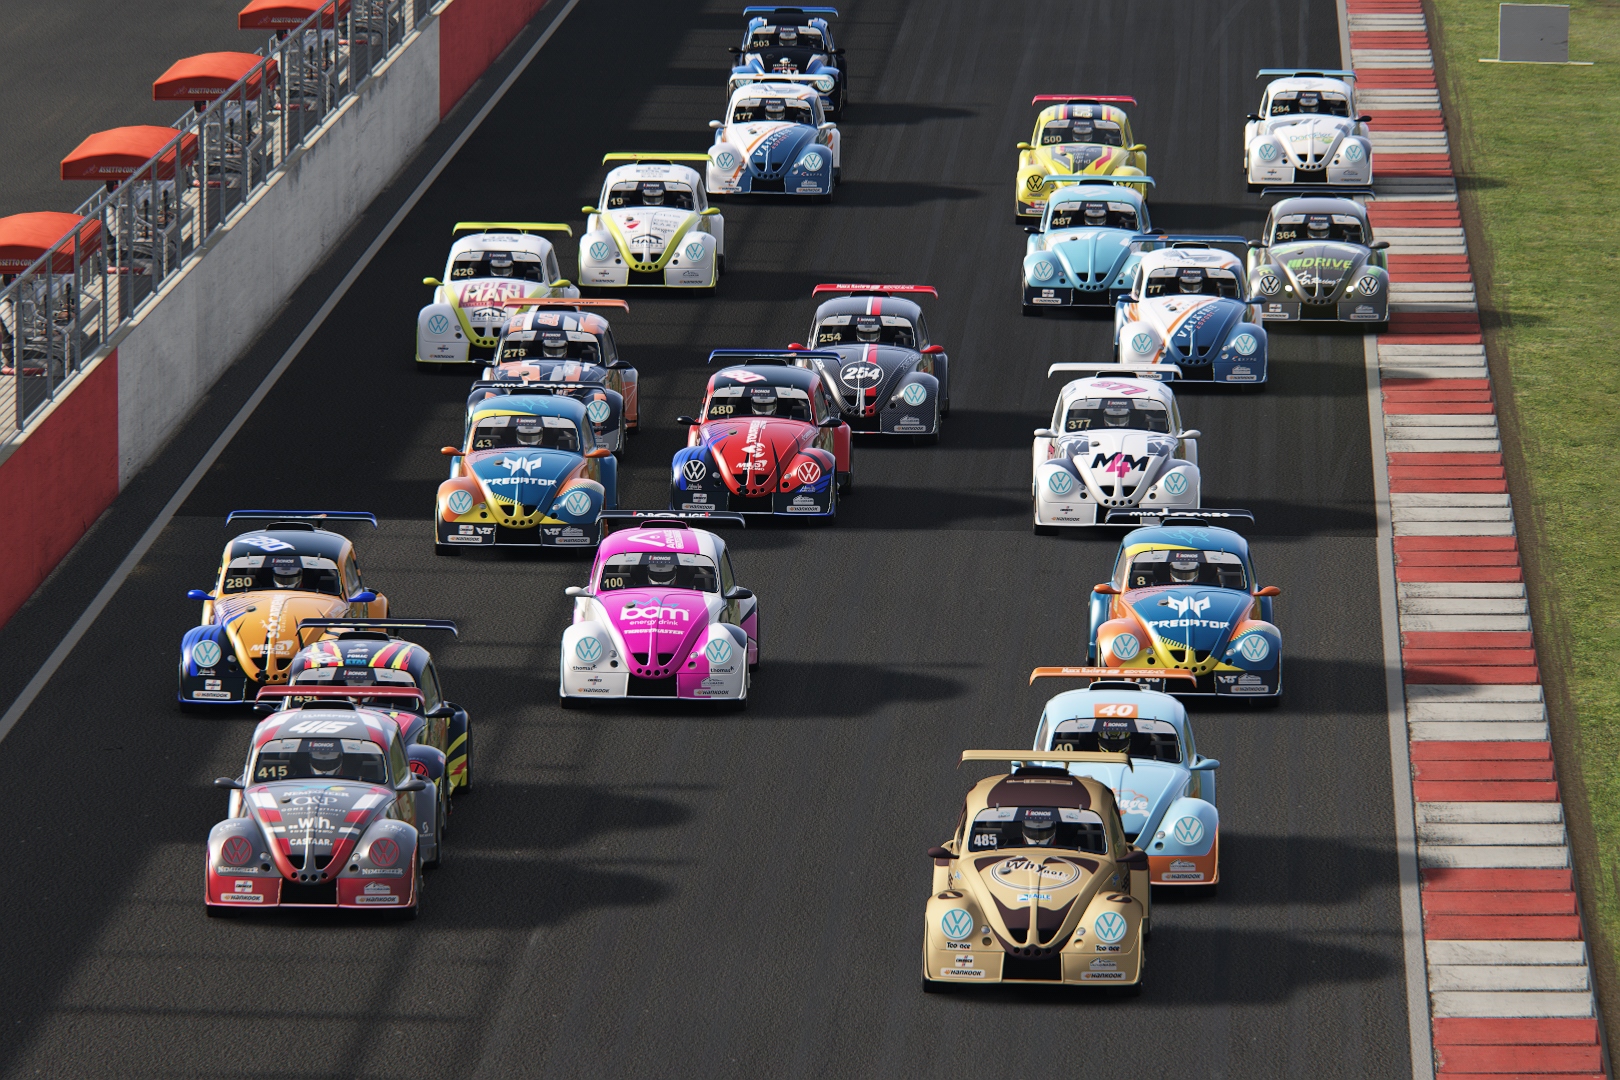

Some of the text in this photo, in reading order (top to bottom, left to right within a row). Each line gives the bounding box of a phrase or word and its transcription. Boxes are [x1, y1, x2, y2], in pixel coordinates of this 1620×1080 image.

[753, 40, 770, 48] 503
[1044, 135, 1062, 144] 500
[610, 198, 624, 206] 19
[1052, 216, 1072, 226] 487
[1276, 230, 1296, 240] 364
[453, 268, 474, 276] 426
[820, 332, 842, 342] 254
[504, 348, 526, 358] 278
[843, 367, 880, 380] 254
[710, 405, 734, 416] 480
[1068, 419, 1092, 430] 377
[476, 439, 492, 448] 43
[1090, 452, 1150, 478] M4M
[484, 477, 557, 488] PREDATOR
[226, 577, 252, 588] 280
[604, 577, 624, 588] 100
[1136, 576, 1146, 586] 8
[1149, 619, 1230, 631] PREDATOR
[1098, 704, 1134, 716] 40
[288, 720, 358, 734] 415
[258, 765, 288, 778] 415
[974, 833, 998, 846] 485
